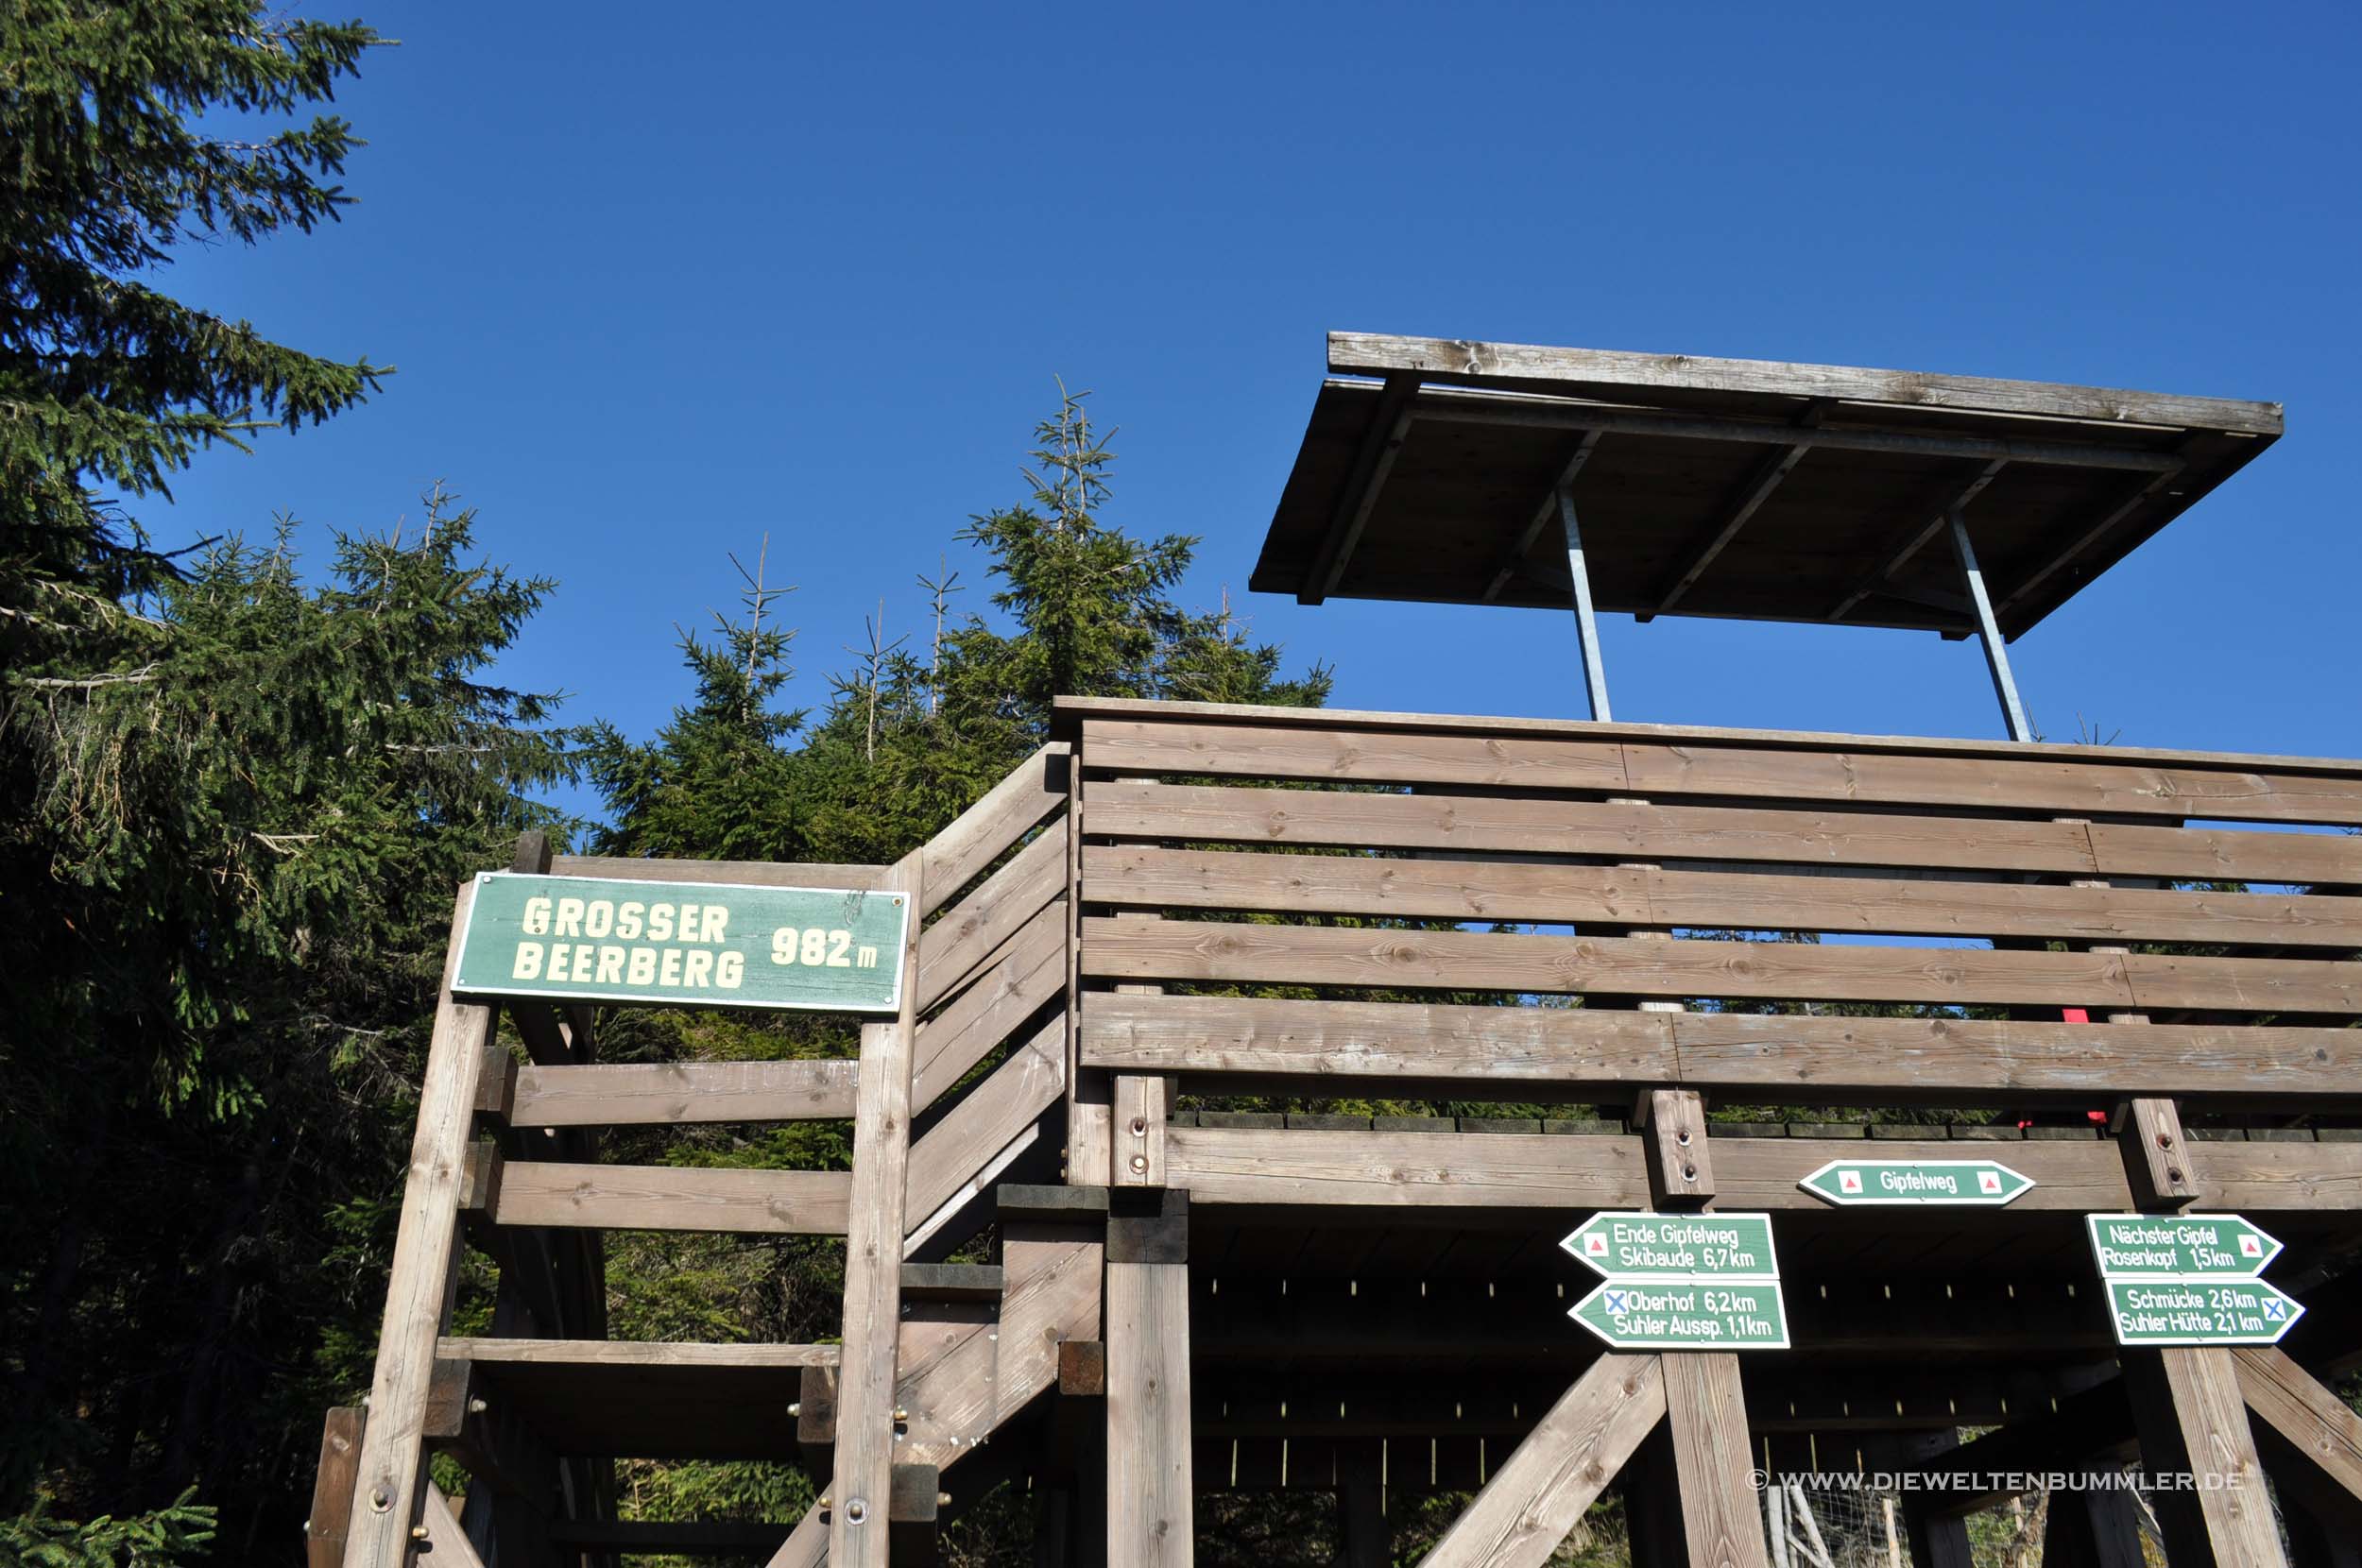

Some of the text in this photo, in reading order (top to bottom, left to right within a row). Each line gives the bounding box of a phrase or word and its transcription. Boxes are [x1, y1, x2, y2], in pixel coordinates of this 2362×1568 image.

[522, 896, 729, 944] GROSSER
[770, 927, 878, 968] 982 m
[512, 942, 745, 989] BEERBERG
[1880, 1170, 1959, 1194] Gipfelweg
[1613, 1223, 1739, 1250] Ende Gipfelweg
[2109, 1224, 2218, 1248] Nächster Gipfel
[1619, 1246, 1695, 1268] Skibaude
[2101, 1247, 2178, 1270] Rosenkopf
[1628, 1290, 1695, 1312] Oberhof
[2127, 1288, 2205, 1309] Schmücke
[1613, 1314, 1668, 1336] Suhler
[1669, 1315, 1724, 1340] Aussp.
[2118, 1312, 2168, 1333] Suhler
[2169, 1312, 2213, 1332] Hütte
